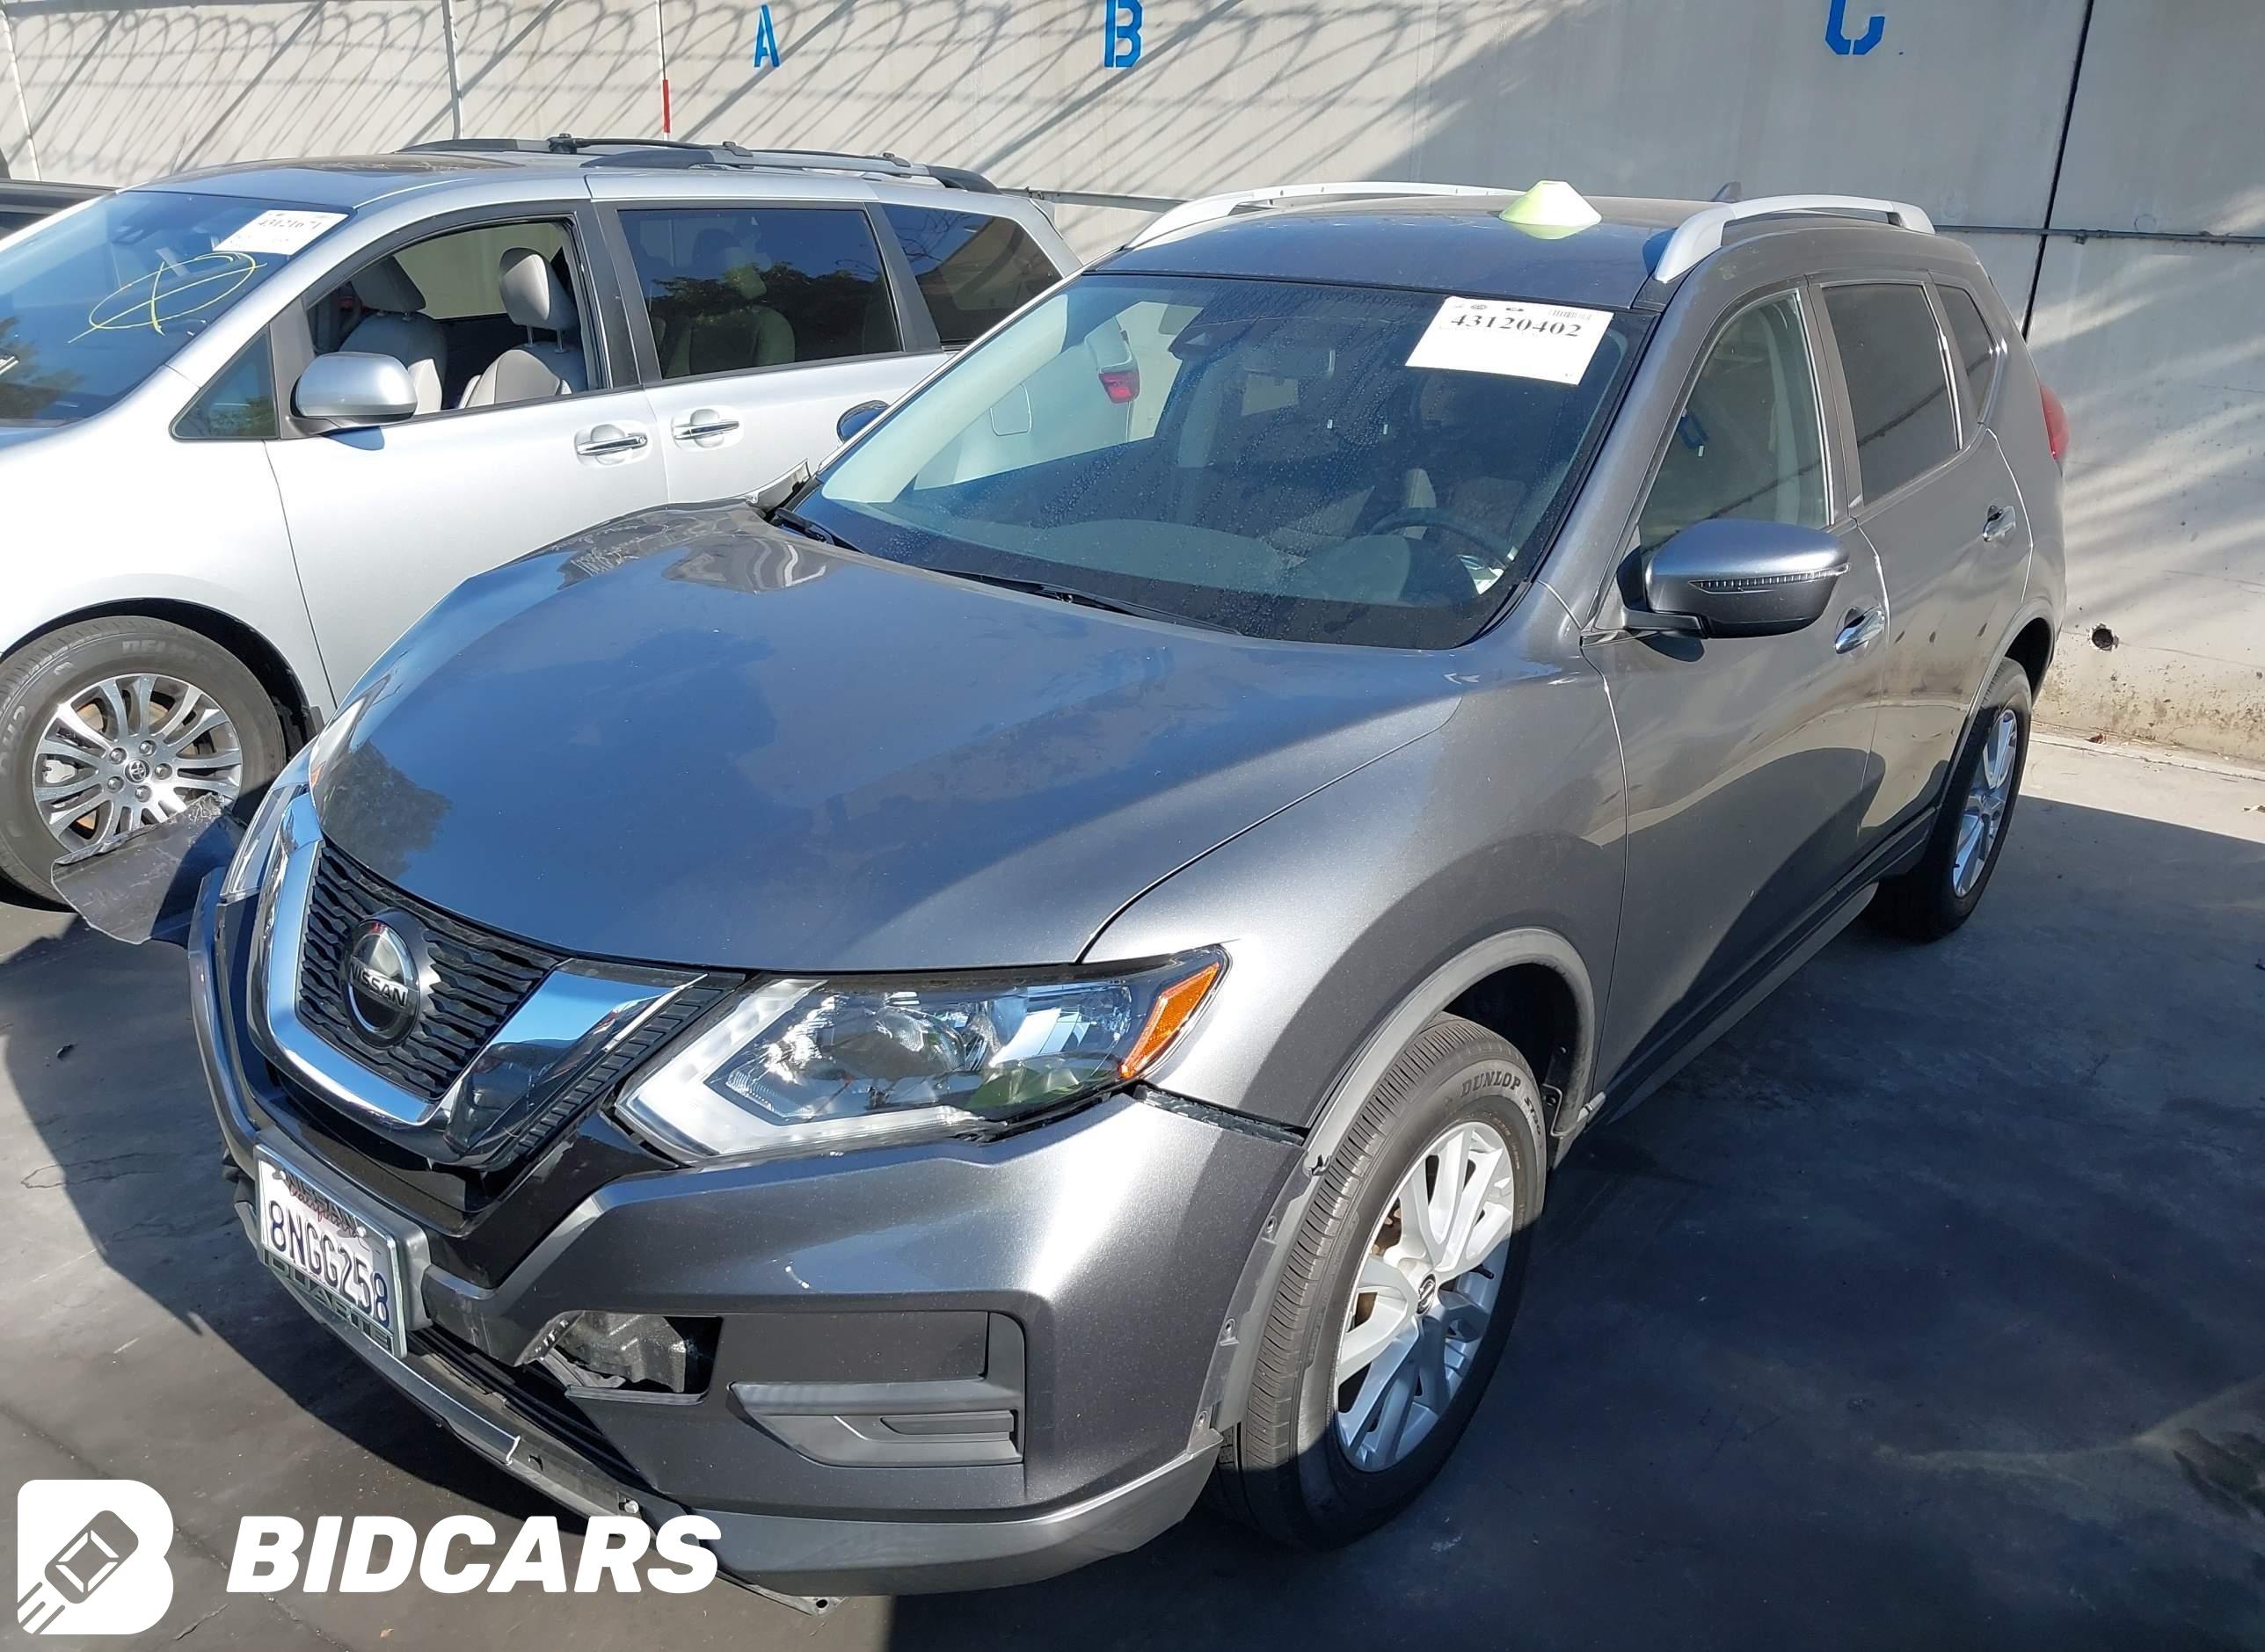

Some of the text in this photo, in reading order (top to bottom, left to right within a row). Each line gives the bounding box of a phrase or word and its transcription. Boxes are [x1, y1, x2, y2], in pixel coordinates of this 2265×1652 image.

[754, 4, 780, 68] A
[1103, 0, 1143, 68] B
[1451, 314, 1582, 337] 43120402
[349, 962, 407, 1007] NISSAN
[1460, 1069, 1522, 1097] DUNLOP
[269, 1199, 390, 1329] 8NGG258
